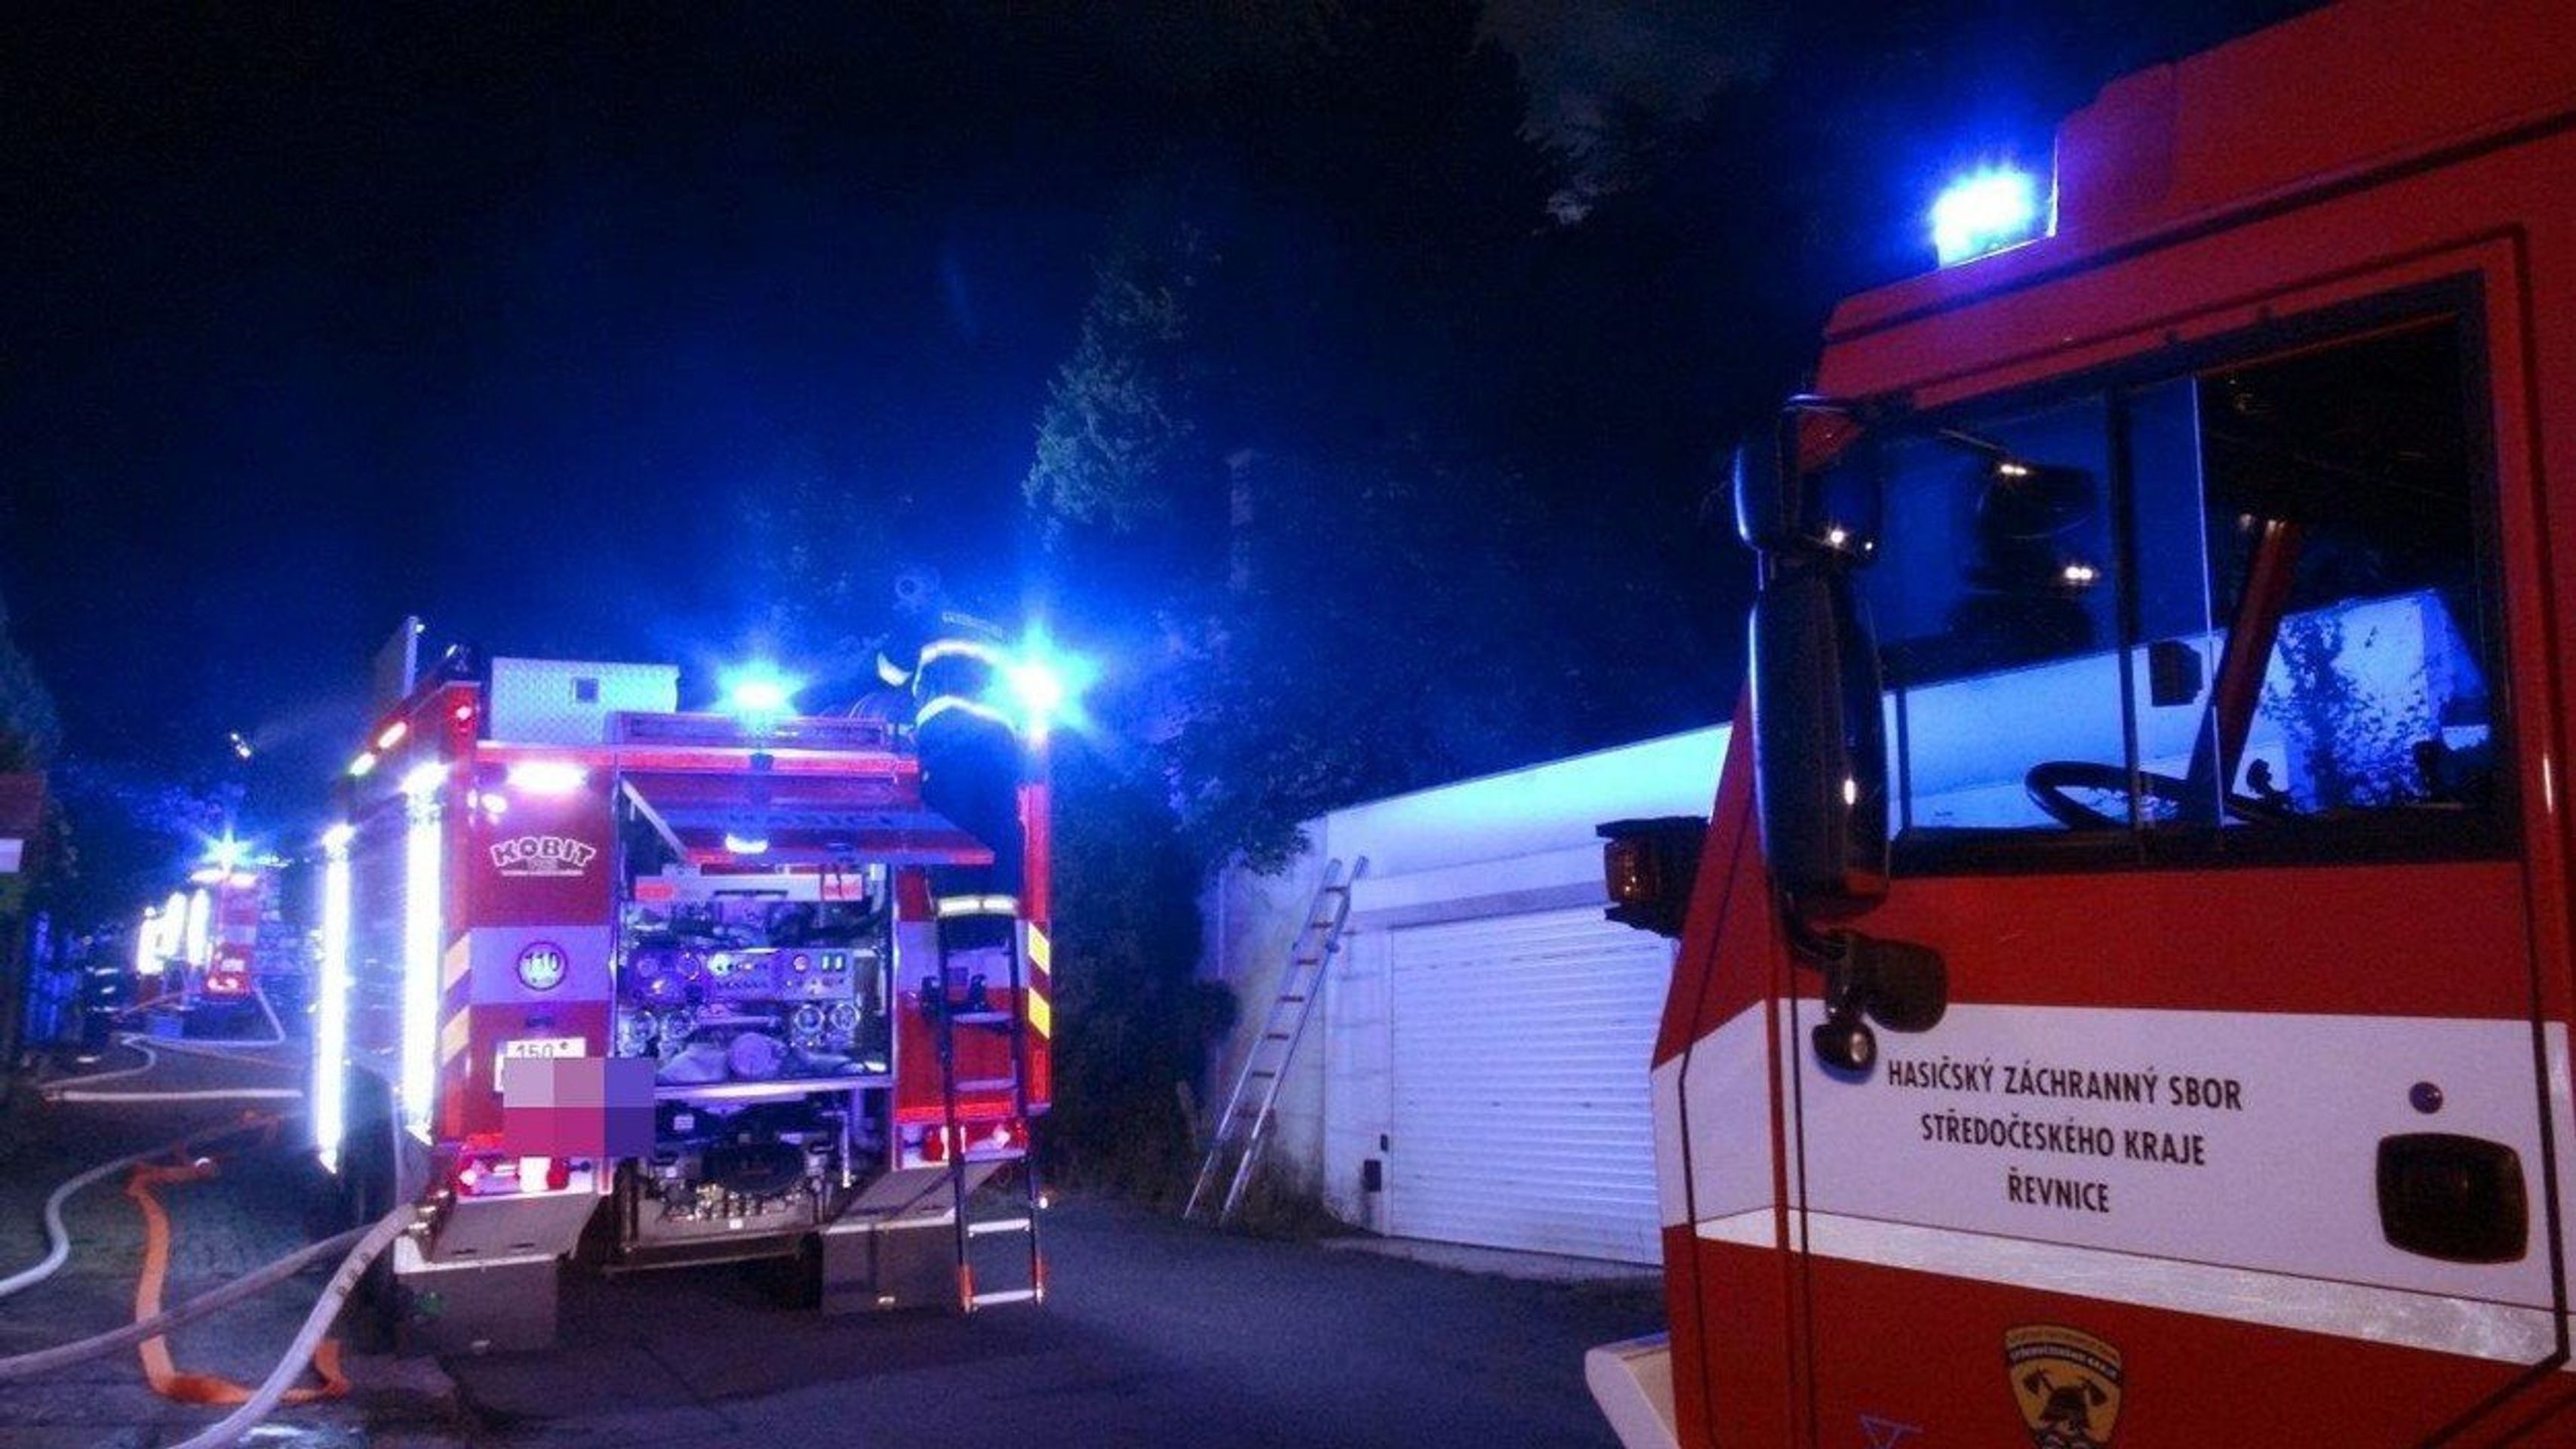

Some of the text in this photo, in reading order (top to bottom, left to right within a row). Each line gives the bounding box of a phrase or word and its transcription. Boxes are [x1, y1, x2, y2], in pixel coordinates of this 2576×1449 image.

[490, 837, 597, 867] KOBIT
[525, 952, 561, 972] 110
[1888, 1055, 2243, 1112] HASIČSKÝ ZÁCHRANNÝ SBOR
[1920, 1108, 2206, 1167] STŘEDOČESKÉHO KRAJE
[2007, 1166, 2110, 1214] ŘEVNICE
